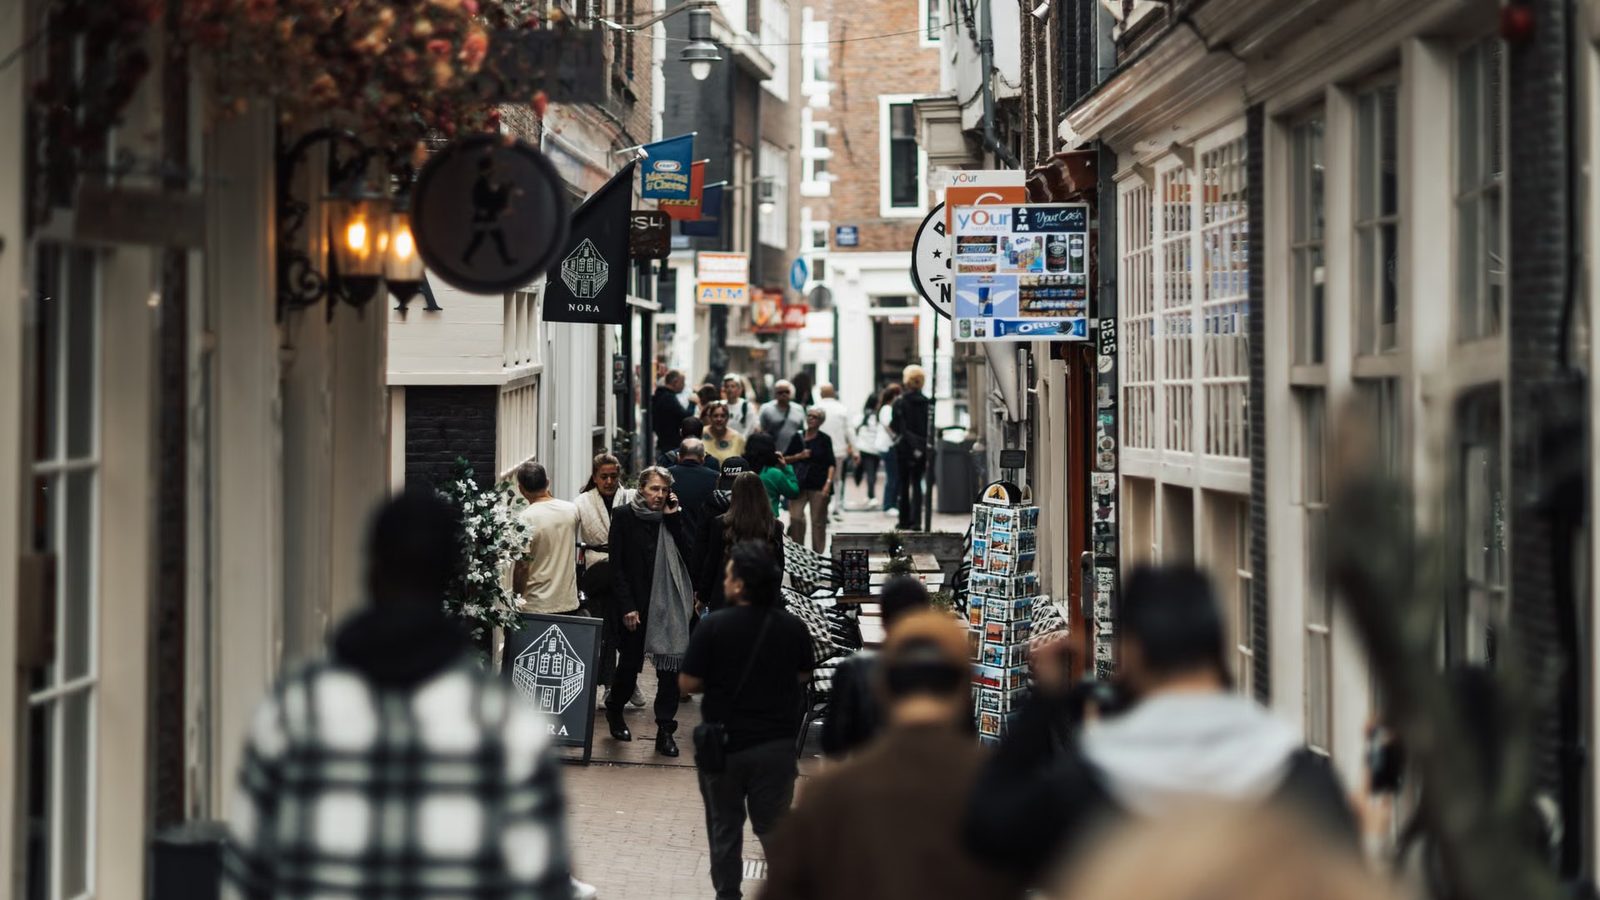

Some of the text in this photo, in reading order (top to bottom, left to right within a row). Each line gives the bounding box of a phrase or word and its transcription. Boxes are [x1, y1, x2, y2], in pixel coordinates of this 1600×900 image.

[646, 172, 687, 183] Macaroni
[654, 181, 687, 191] Cheese
[703, 288, 742, 299] ATM
[568, 303, 600, 312] NORA
[1018, 320, 1059, 333] OREO
